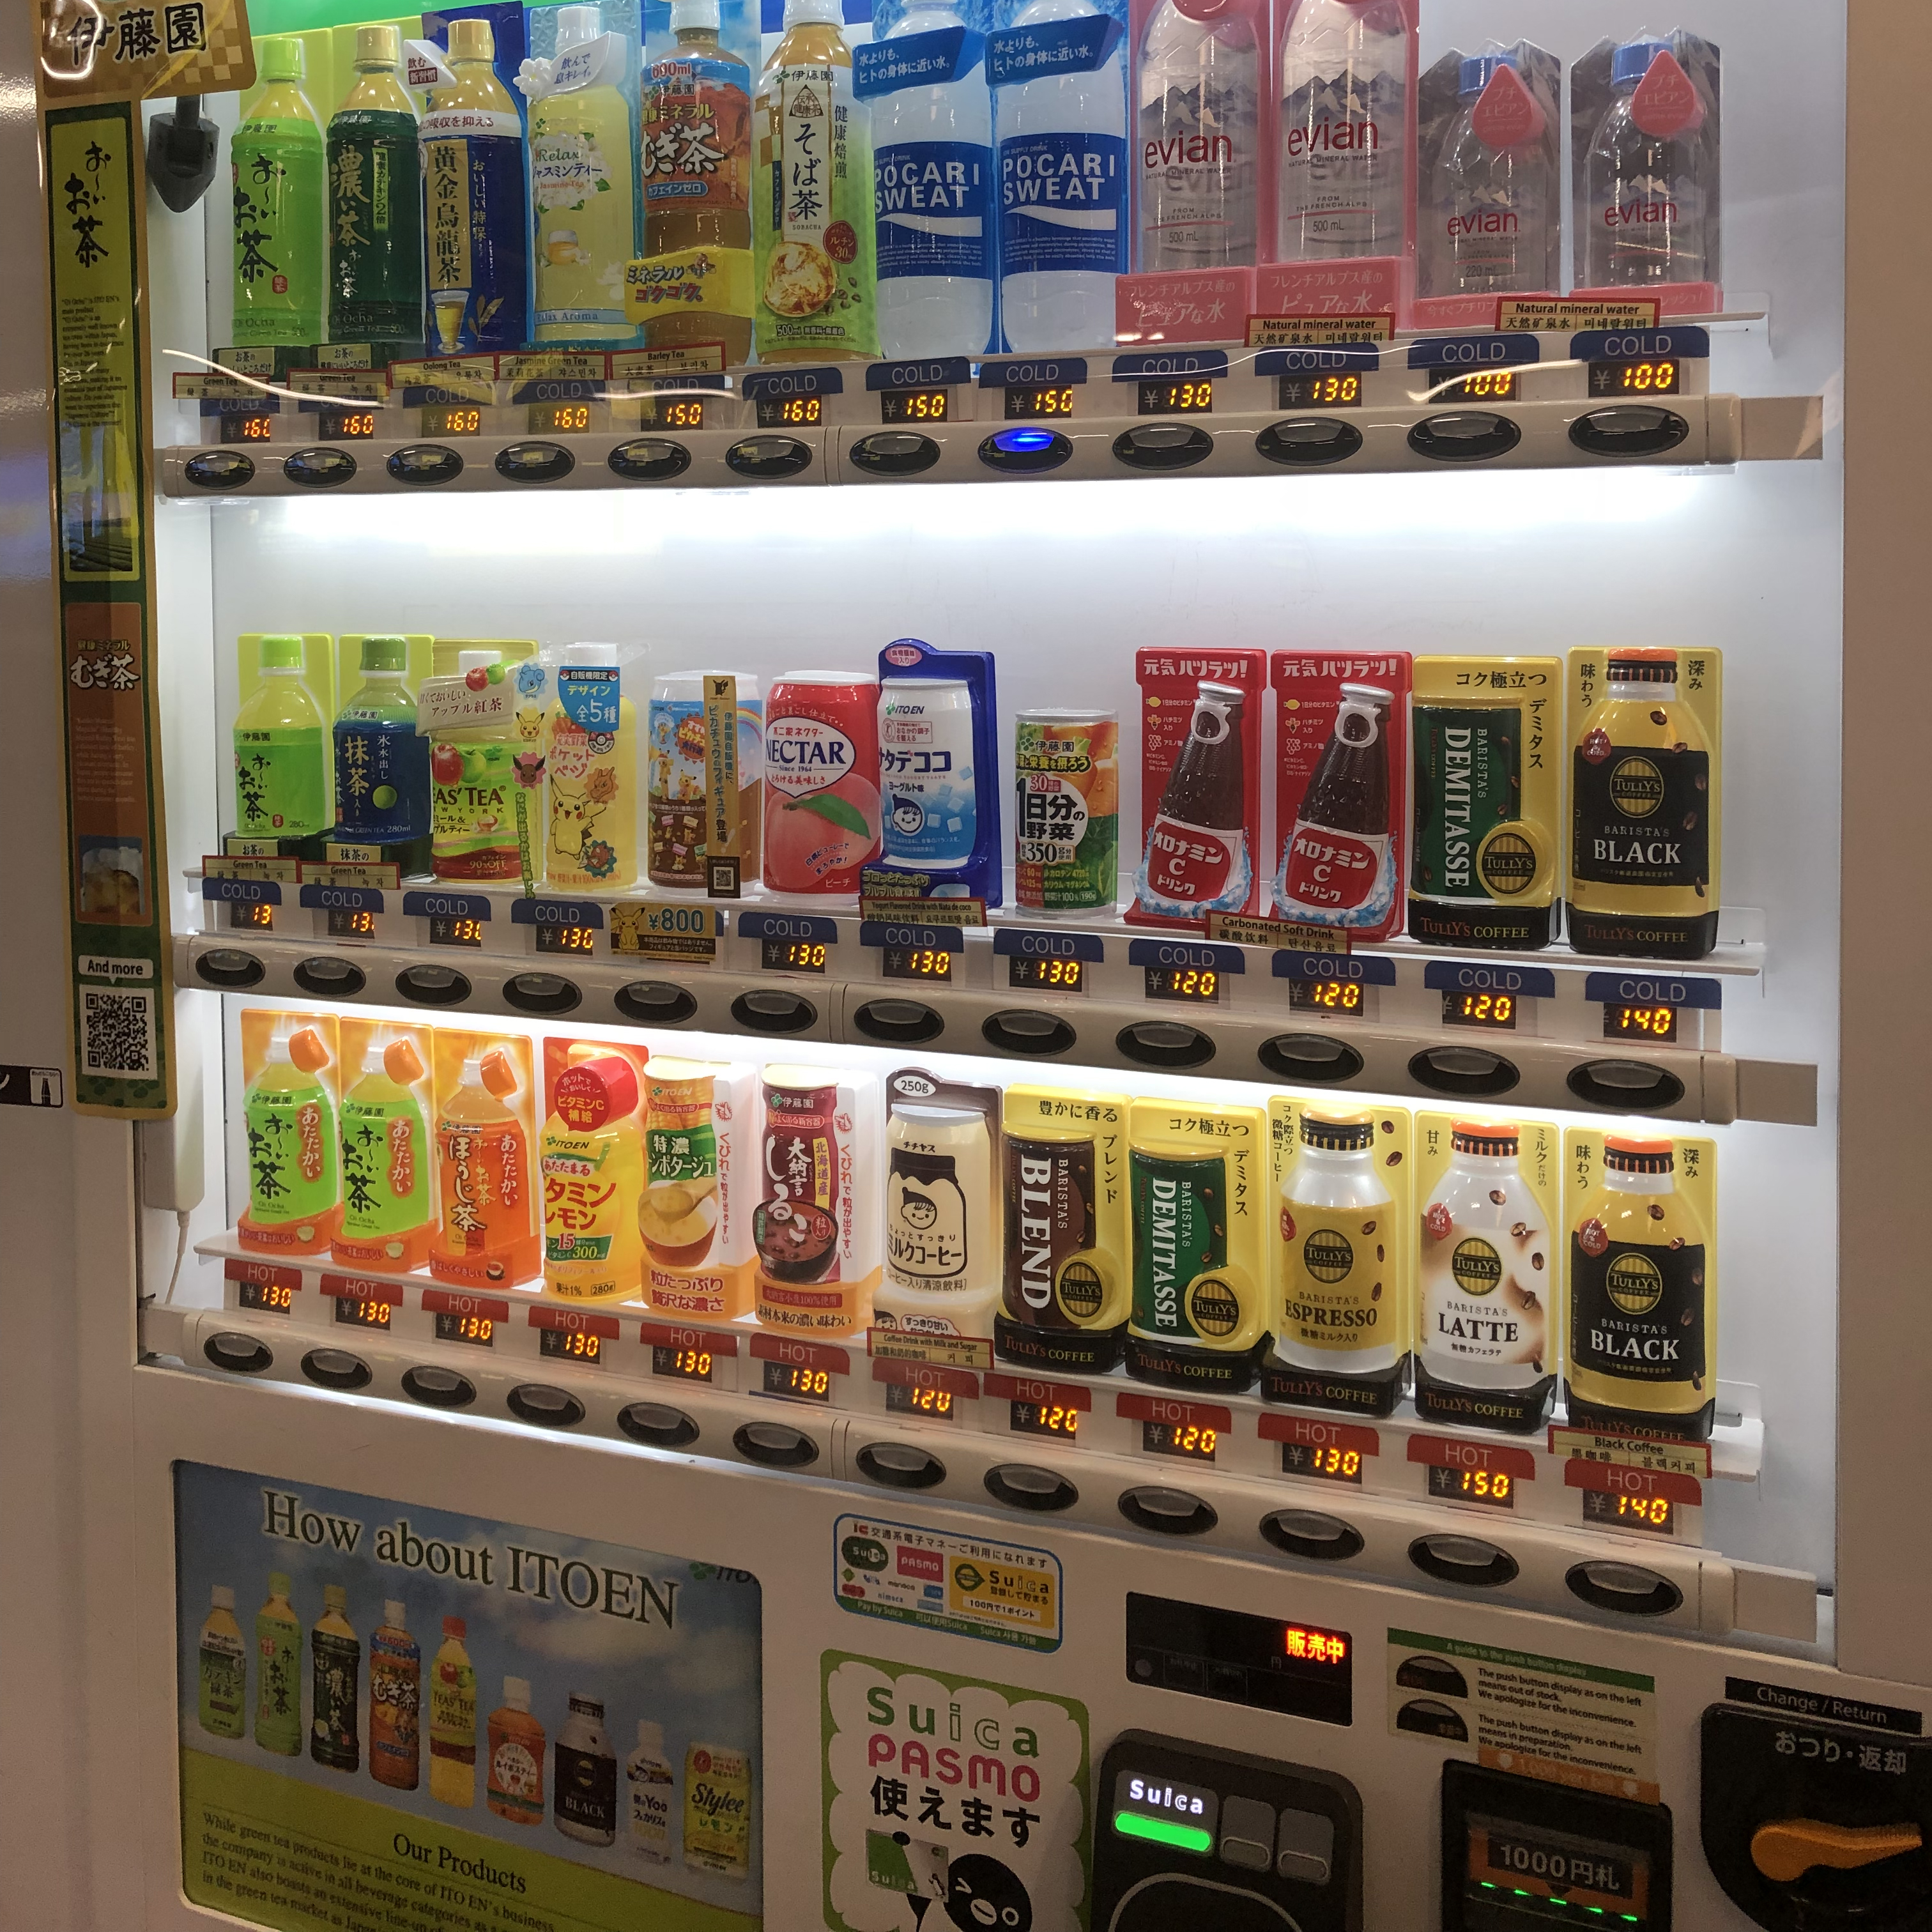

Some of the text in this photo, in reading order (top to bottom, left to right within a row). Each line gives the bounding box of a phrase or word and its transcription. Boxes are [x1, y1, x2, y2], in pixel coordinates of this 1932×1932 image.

[69, 1, 207, 65] 伊藤園
[791, 70, 833, 82] 伊藤園
[642, 122, 724, 176] むぎ茶
[1287, 116, 1378, 157] evian
[537, 148, 579, 162] Relax
[1145, 130, 1233, 169] evian
[790, 123, 823, 220] そば茶
[874, 162, 979, 187] POCARI
[1002, 153, 1115, 184] POCARI
[874, 185, 969, 214] SWEAT
[1003, 178, 1105, 206] SWEAT
[1446, 210, 1519, 237] evian
[1604, 199, 1678, 227] evian
[626, 264, 684, 284] ミネラル
[1262, 318, 1376, 331] Natural mineral water
[647, 351, 685, 362] Barley Tea
[1604, 335, 1673, 356] COLD
[1285, 351, 1347, 370] COLD
[768, 375, 816, 394] COLD
[891, 364, 943, 384] COLD
[1006, 364, 1059, 383] COLD
[536, 383, 582, 399] COLD
[69, 655, 140, 691] むぎ茶
[570, 670, 608, 681] 自販機限定
[1580, 663, 1596, 708] 味わう
[1687, 659, 1705, 690] 深み
[567, 685, 610, 696] デザイン
[576, 699, 618, 724] 全5種
[1528, 698, 1544, 769] デミタス
[1035, 740, 1075, 753] 伊藤園
[1476, 728, 1489, 799] BARISTA'S
[468, 786, 505, 806] TEA
[1444, 726, 1472, 888] DEMITASSE
[1027, 822, 1075, 841] 野菜
[1604, 825, 1671, 839] BARISTA'S
[1026, 842, 1057, 862] 350
[1153, 831, 1223, 864] オロナミン
[1593, 838, 1682, 864] BLACK
[233, 861, 267, 870] Green Tea
[1169, 858, 1186, 876] C
[222, 883, 261, 901] COLD
[1157, 874, 1196, 895] ドリンク
[321, 891, 363, 908] COLD
[648, 908, 704, 934] ¥800
[1222, 916, 1335, 940] Carbonated Soft Drink
[1473, 925, 1529, 939] COFFEE
[88, 959, 143, 976] And more
[900, 1080, 930, 1094] 250g
[567, 1111, 593, 1124] 補給
[1038, 1100, 1118, 1123] 豊かに香る
[300, 1107, 321, 1177] あたたかい
[653, 1135, 690, 1155] 特濃
[1427, 1129, 1440, 1156] 甘み
[391, 1121, 411, 1192] あたたかい
[785, 1137, 812, 1196] 大納言
[815, 1141, 829, 1196] 北海道産
[1102, 1134, 1118, 1204] ブレンド
[448, 1135, 487, 1233] ほうじ茶
[1056, 1158, 1070, 1230] BARISTA'S
[1234, 1149, 1248, 1216] デミタス
[1181, 1181, 1192, 1248] BARISTA'S
[1020, 1154, 1052, 1309] BLEND
[1151, 1176, 1177, 1328] DEMITASSE
[248, 1264, 278, 1282] HOT
[650, 1269, 724, 1291] 粒たっぷり
[448, 1296, 482, 1314] HOT
[1299, 1291, 1360, 1305] BARISTA'S
[1285, 1298, 1378, 1327] ESPRESSO
[670, 1328, 707, 1348] HOT
[1438, 1312, 1519, 1343] LATTE
[779, 1344, 818, 1364] HOT
[1048, 1349, 1094, 1363] COFFEE
[1590, 1329, 1680, 1361] BLACK
[1016, 1382, 1058, 1402] HOT
[1474, 1403, 1524, 1420] COFFEE
[1296, 1422, 1341, 1445] HOT
[1595, 1436, 1664, 1455] Black Coffee
[263, 1489, 680, 1630] How about ITOEN
[989, 1570, 1050, 1594] Suica
[1286, 1629, 1346, 1664] 販売中
[1478, 1667, 1642, 1707] The push button display as on the left
[1756, 1686, 1888, 1725] Change Return
[866, 1686, 1040, 1759] Suica
[1775, 1731, 1907, 1776] おつり・返却
[868, 1733, 1041, 1802] PASMO
[564, 1795, 606, 1819] BLACK
[1129, 1778, 1204, 1815] Suica
[870, 1774, 1041, 1848] 使えます
[393, 1833, 527, 1893] Our Products
[1499, 1844, 1621, 1892] 1000円札
